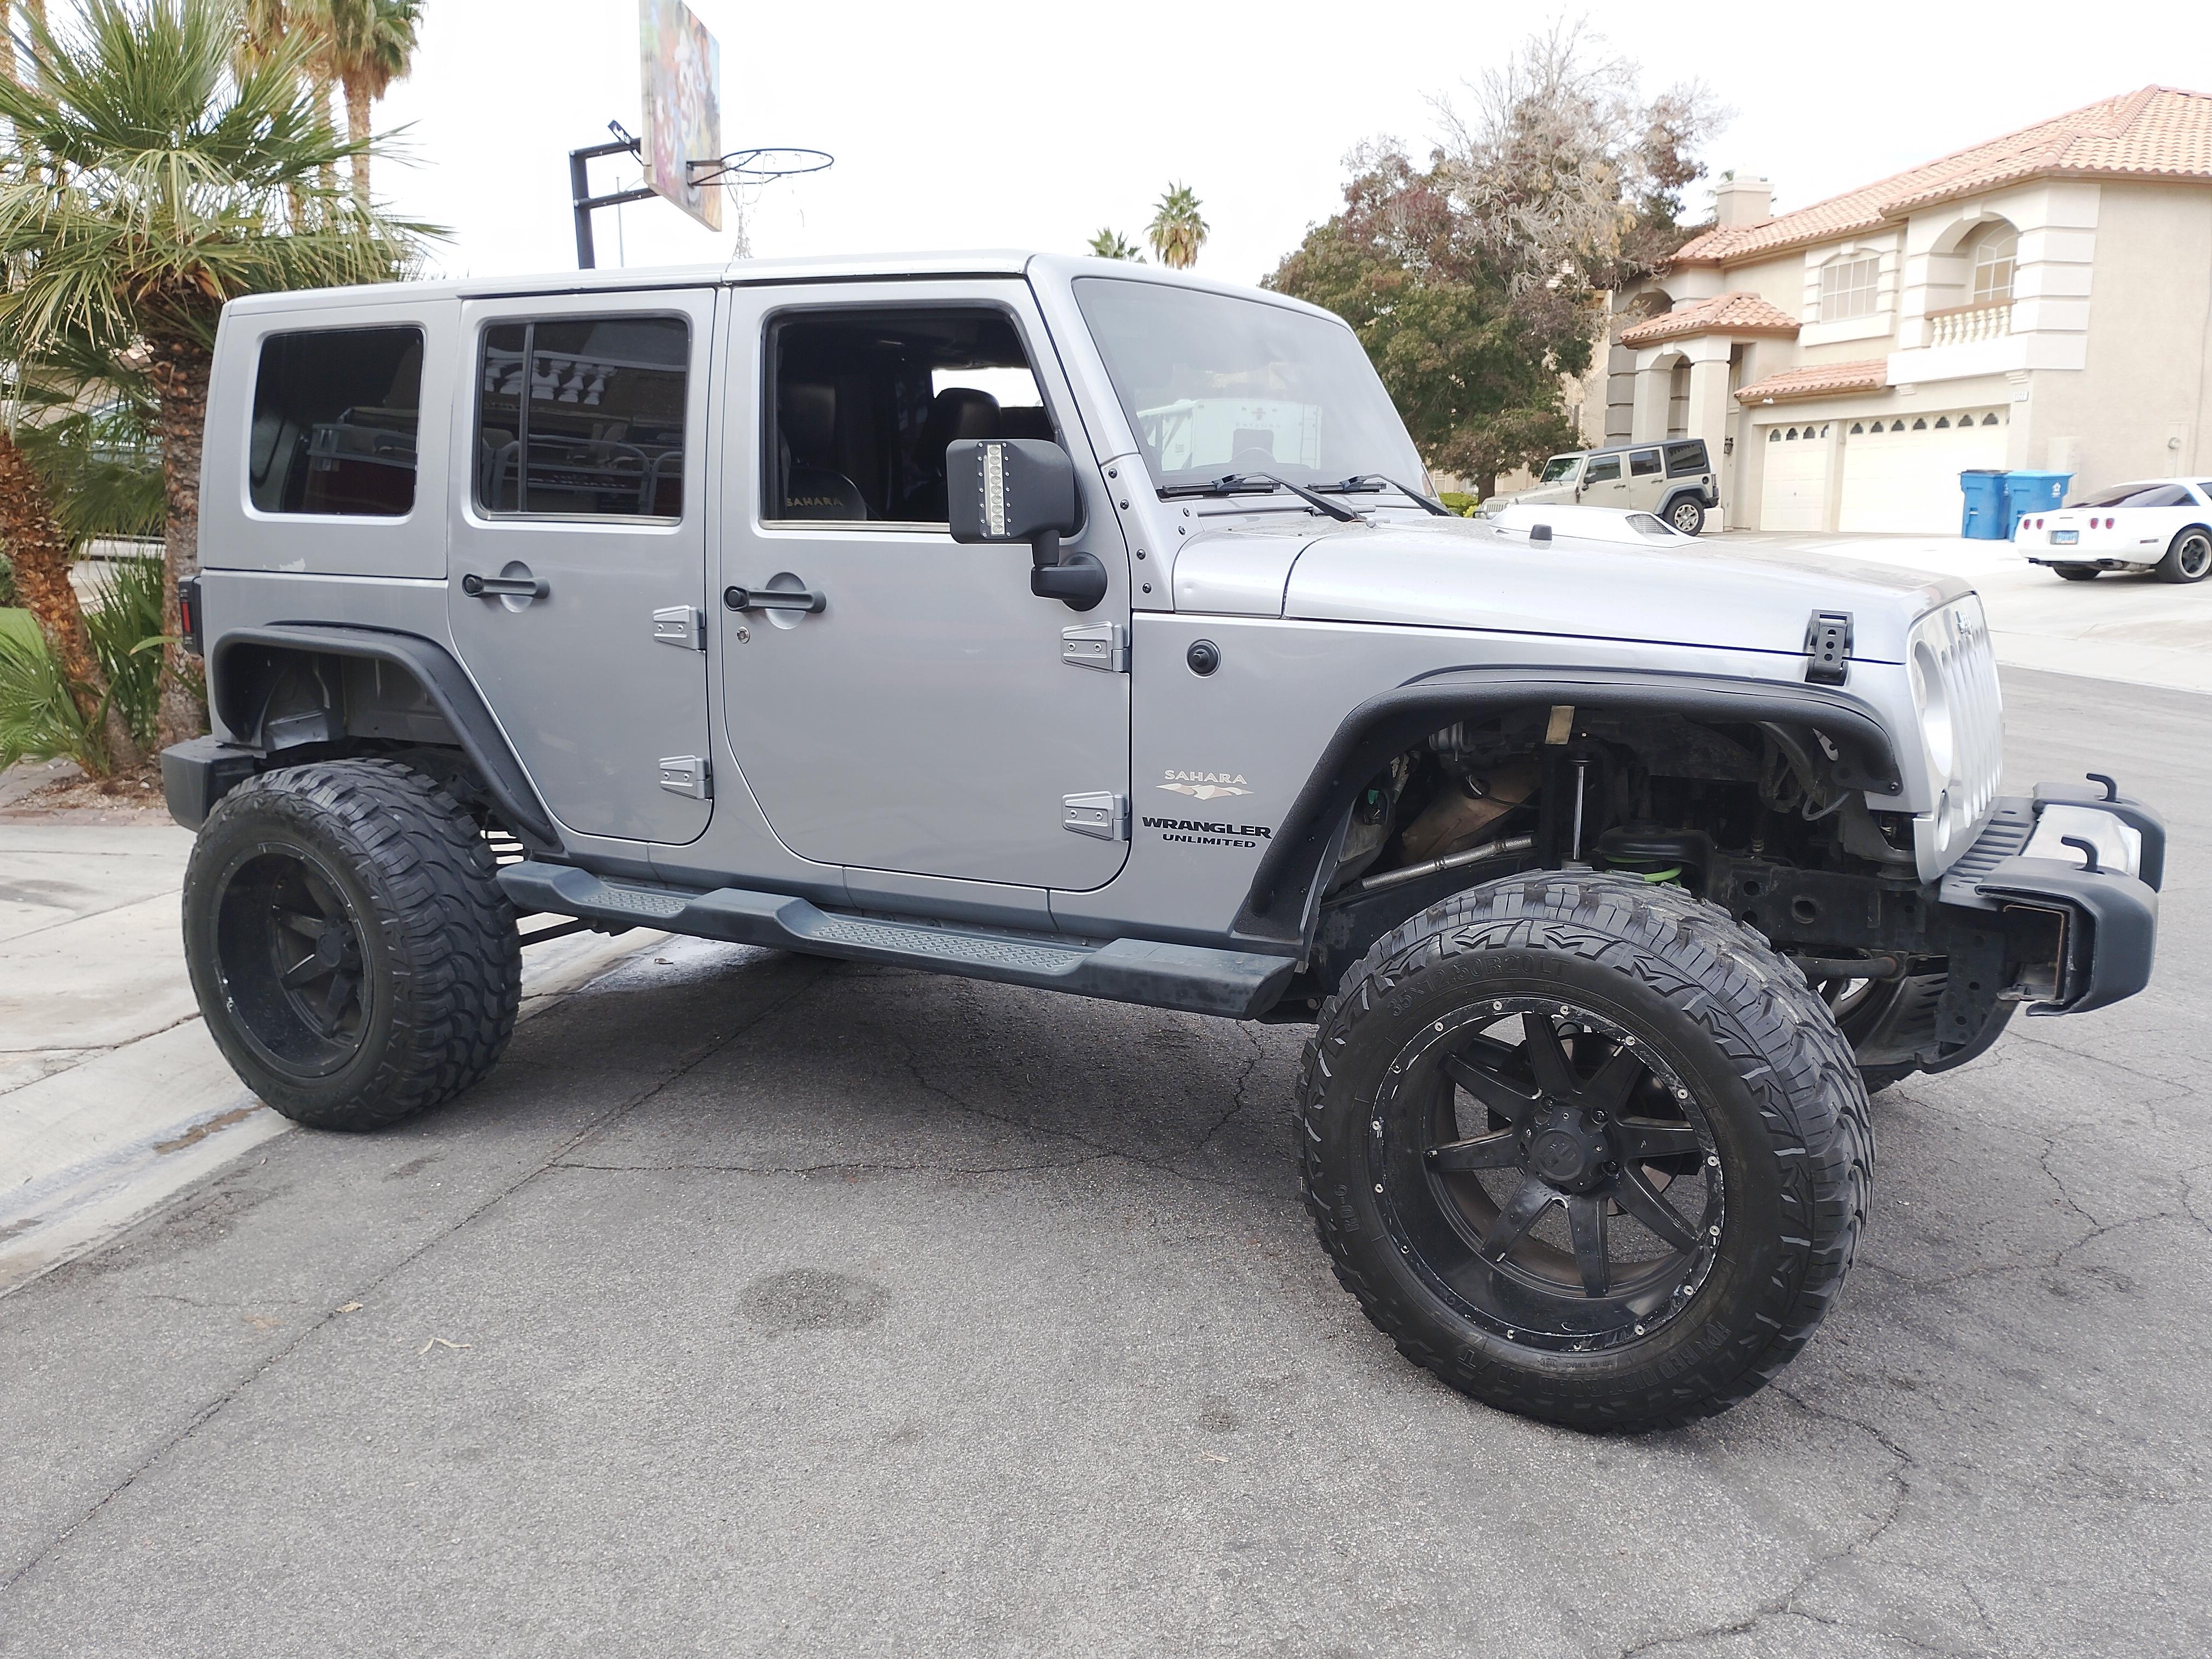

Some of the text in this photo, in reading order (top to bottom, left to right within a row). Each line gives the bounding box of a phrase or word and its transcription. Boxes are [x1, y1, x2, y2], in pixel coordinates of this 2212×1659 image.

[787, 497, 843, 507] SAHARA
[1165, 770, 1248, 785] SAHARA
[1142, 816, 1273, 839] WRANGLER
[1162, 834, 1256, 848] UNLIMITED
[1658, 1344, 1702, 1379] RED
[1609, 1366, 1660, 1396] DIRT
